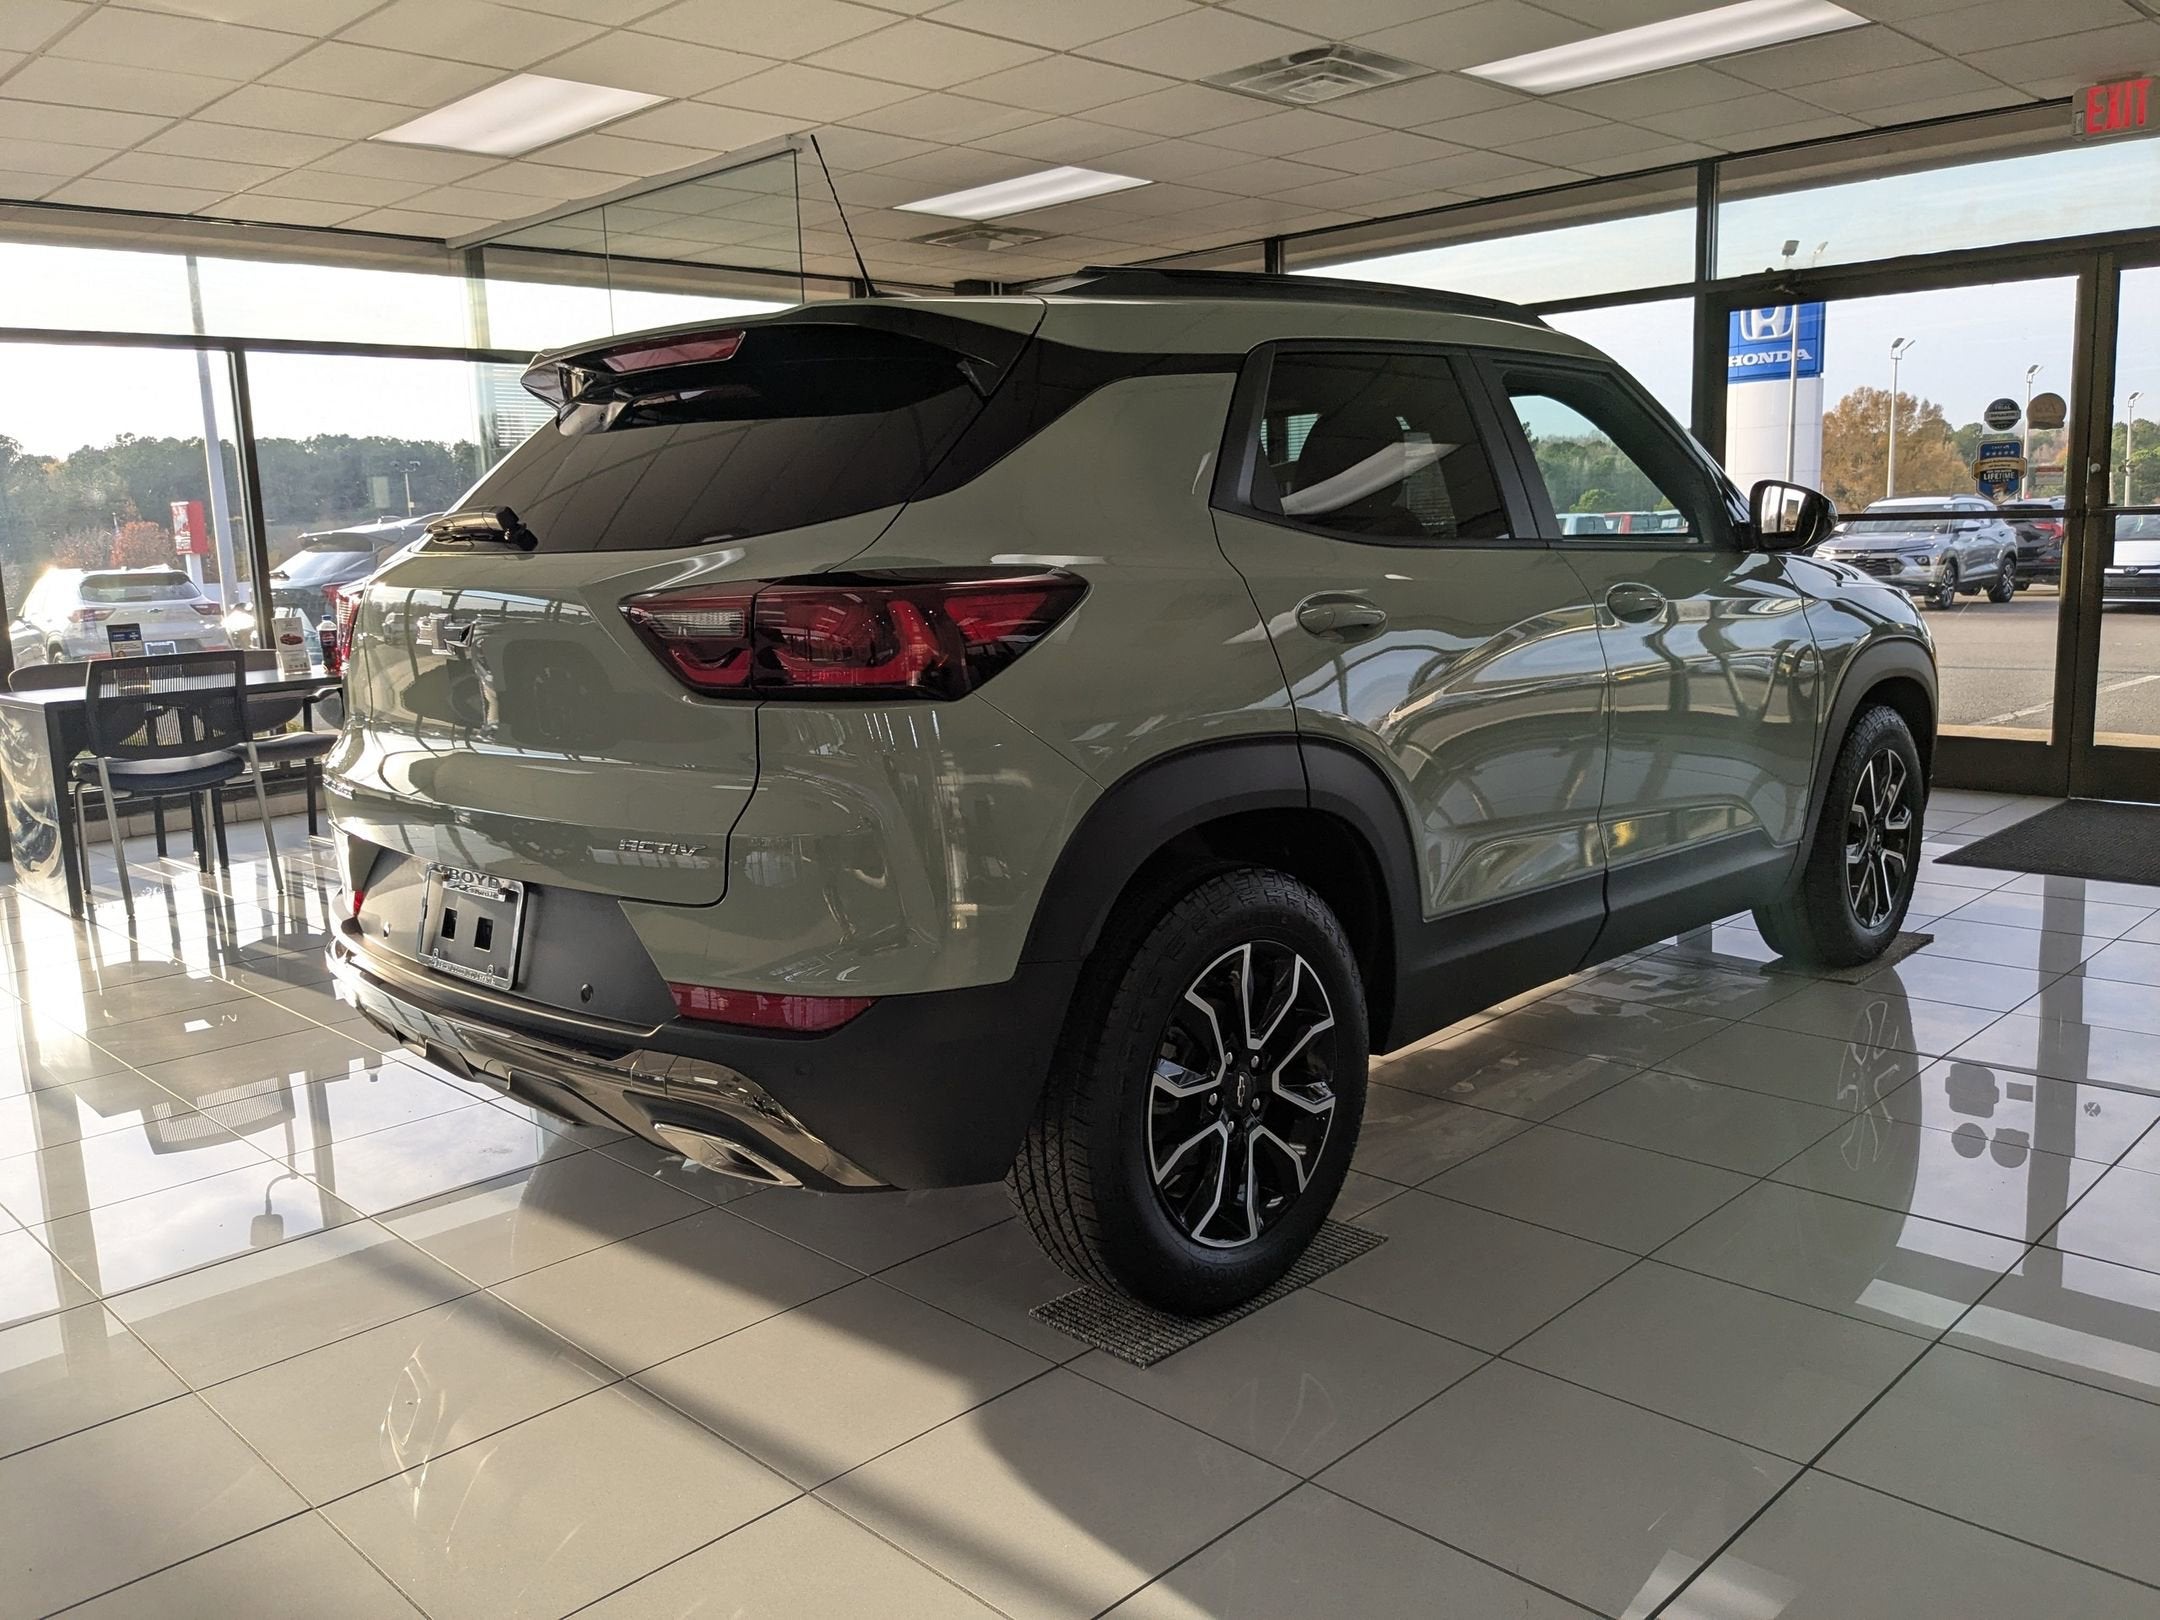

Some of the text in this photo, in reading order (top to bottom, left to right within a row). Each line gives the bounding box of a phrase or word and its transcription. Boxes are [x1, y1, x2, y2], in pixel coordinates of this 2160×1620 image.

[2086, 78, 2152, 133] EXIT
[1728, 348, 1813, 368] HONDA
[1983, 471, 2016, 481] LIFETIME
[618, 839, 707, 857] ACTIV
[448, 868, 501, 889] BOYD
